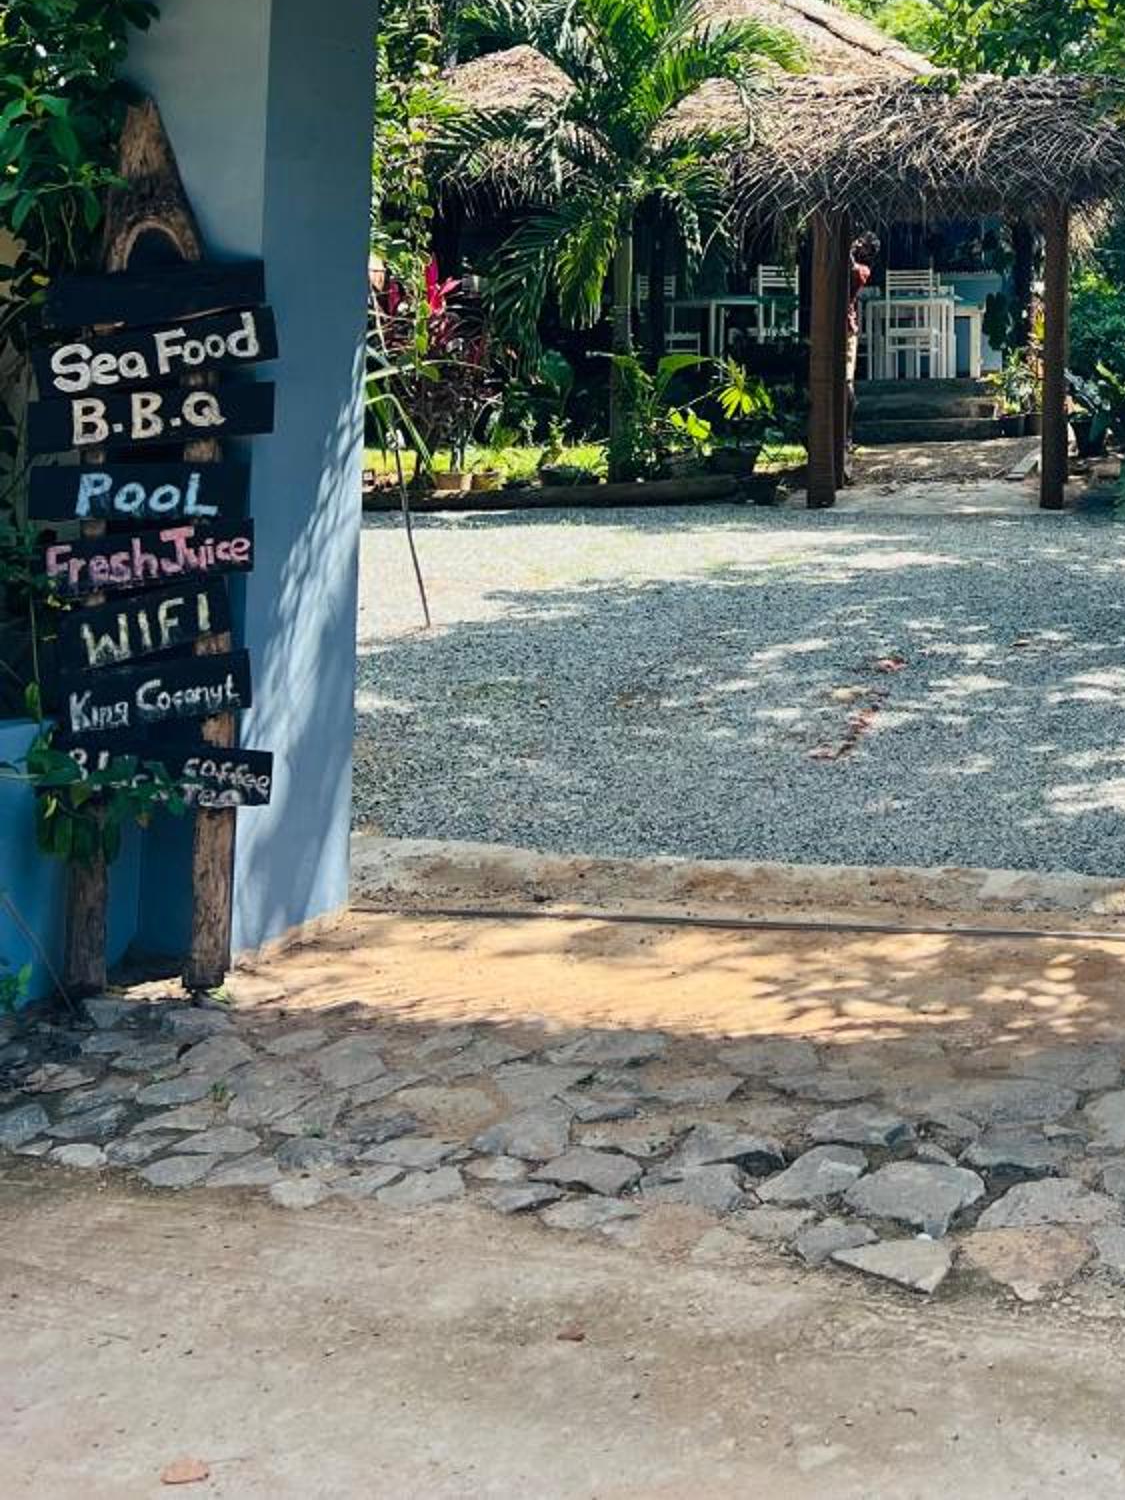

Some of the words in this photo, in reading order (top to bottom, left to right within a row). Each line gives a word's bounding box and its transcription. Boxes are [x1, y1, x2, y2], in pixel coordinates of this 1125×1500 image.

[50, 343, 147, 393] Sea
[153, 311, 261, 376] Food
[71, 391, 227, 446] B.B.Q
[46, 537, 159, 590] Fresh
[160, 525, 251, 573] Juice
[80, 593, 211, 666] WIFI
[69, 690, 131, 733] King
[136, 673, 240, 712] Coconut
